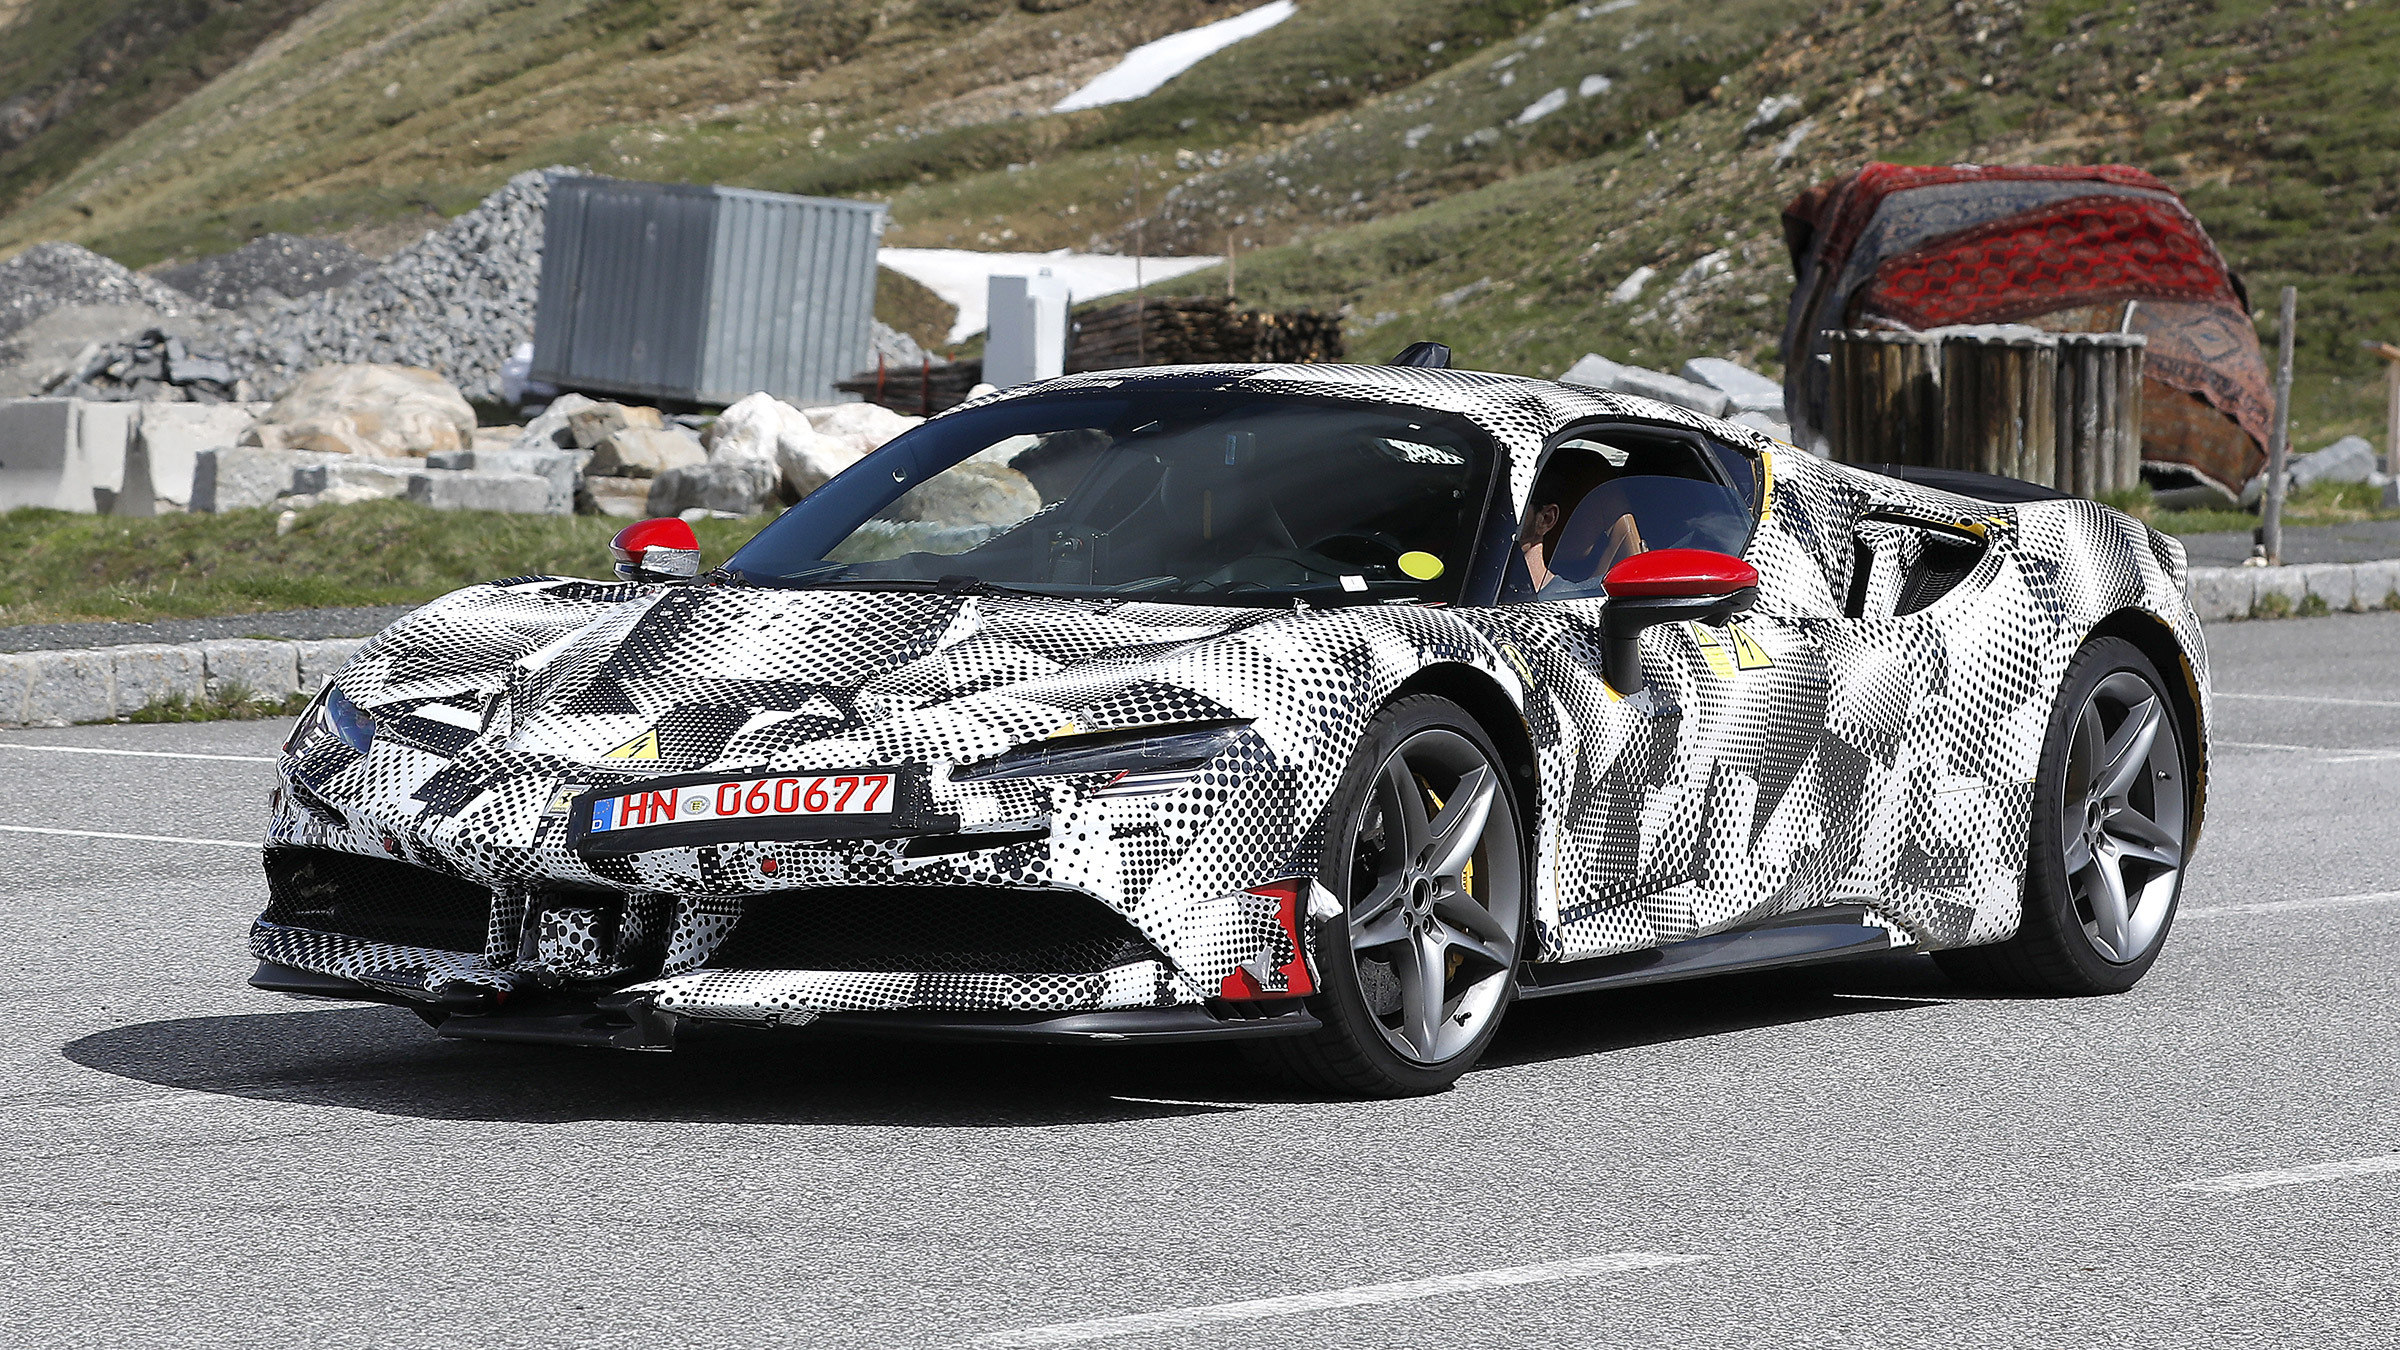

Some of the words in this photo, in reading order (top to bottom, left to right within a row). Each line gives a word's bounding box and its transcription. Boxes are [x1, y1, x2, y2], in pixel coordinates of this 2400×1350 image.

[620, 788, 678, 826] HN
[716, 775, 888, 815] 060677
[592, 820, 603, 830] D
